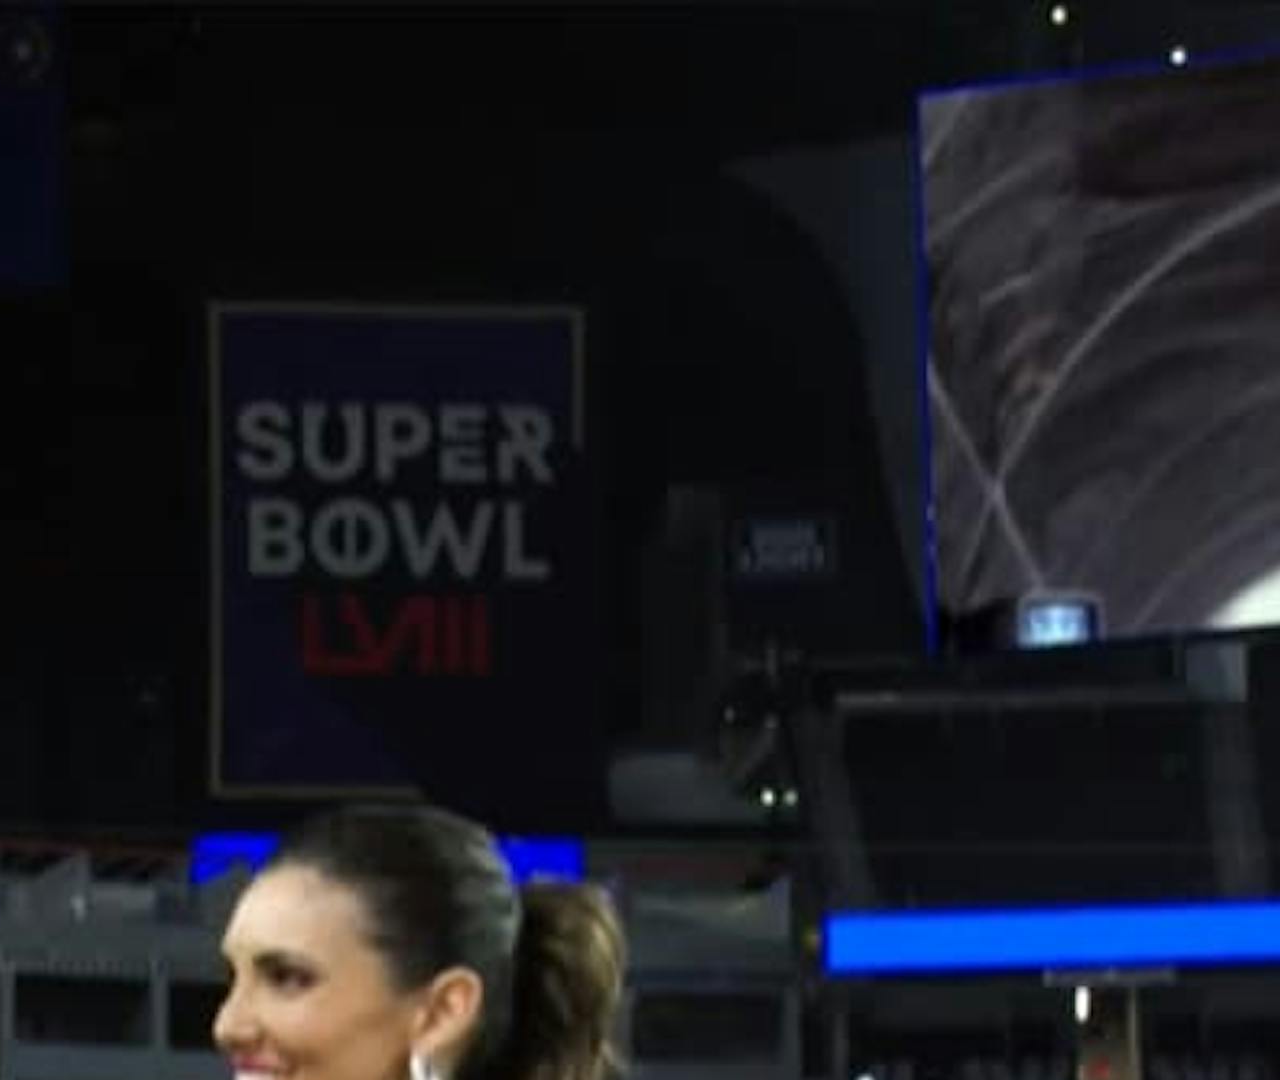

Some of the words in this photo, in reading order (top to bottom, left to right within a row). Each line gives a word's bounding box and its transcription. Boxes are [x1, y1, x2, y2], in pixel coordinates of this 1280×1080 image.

[235, 399, 554, 484] SUPER
[246, 498, 551, 580] BOWL
[300, 592, 490, 676] LVIII
